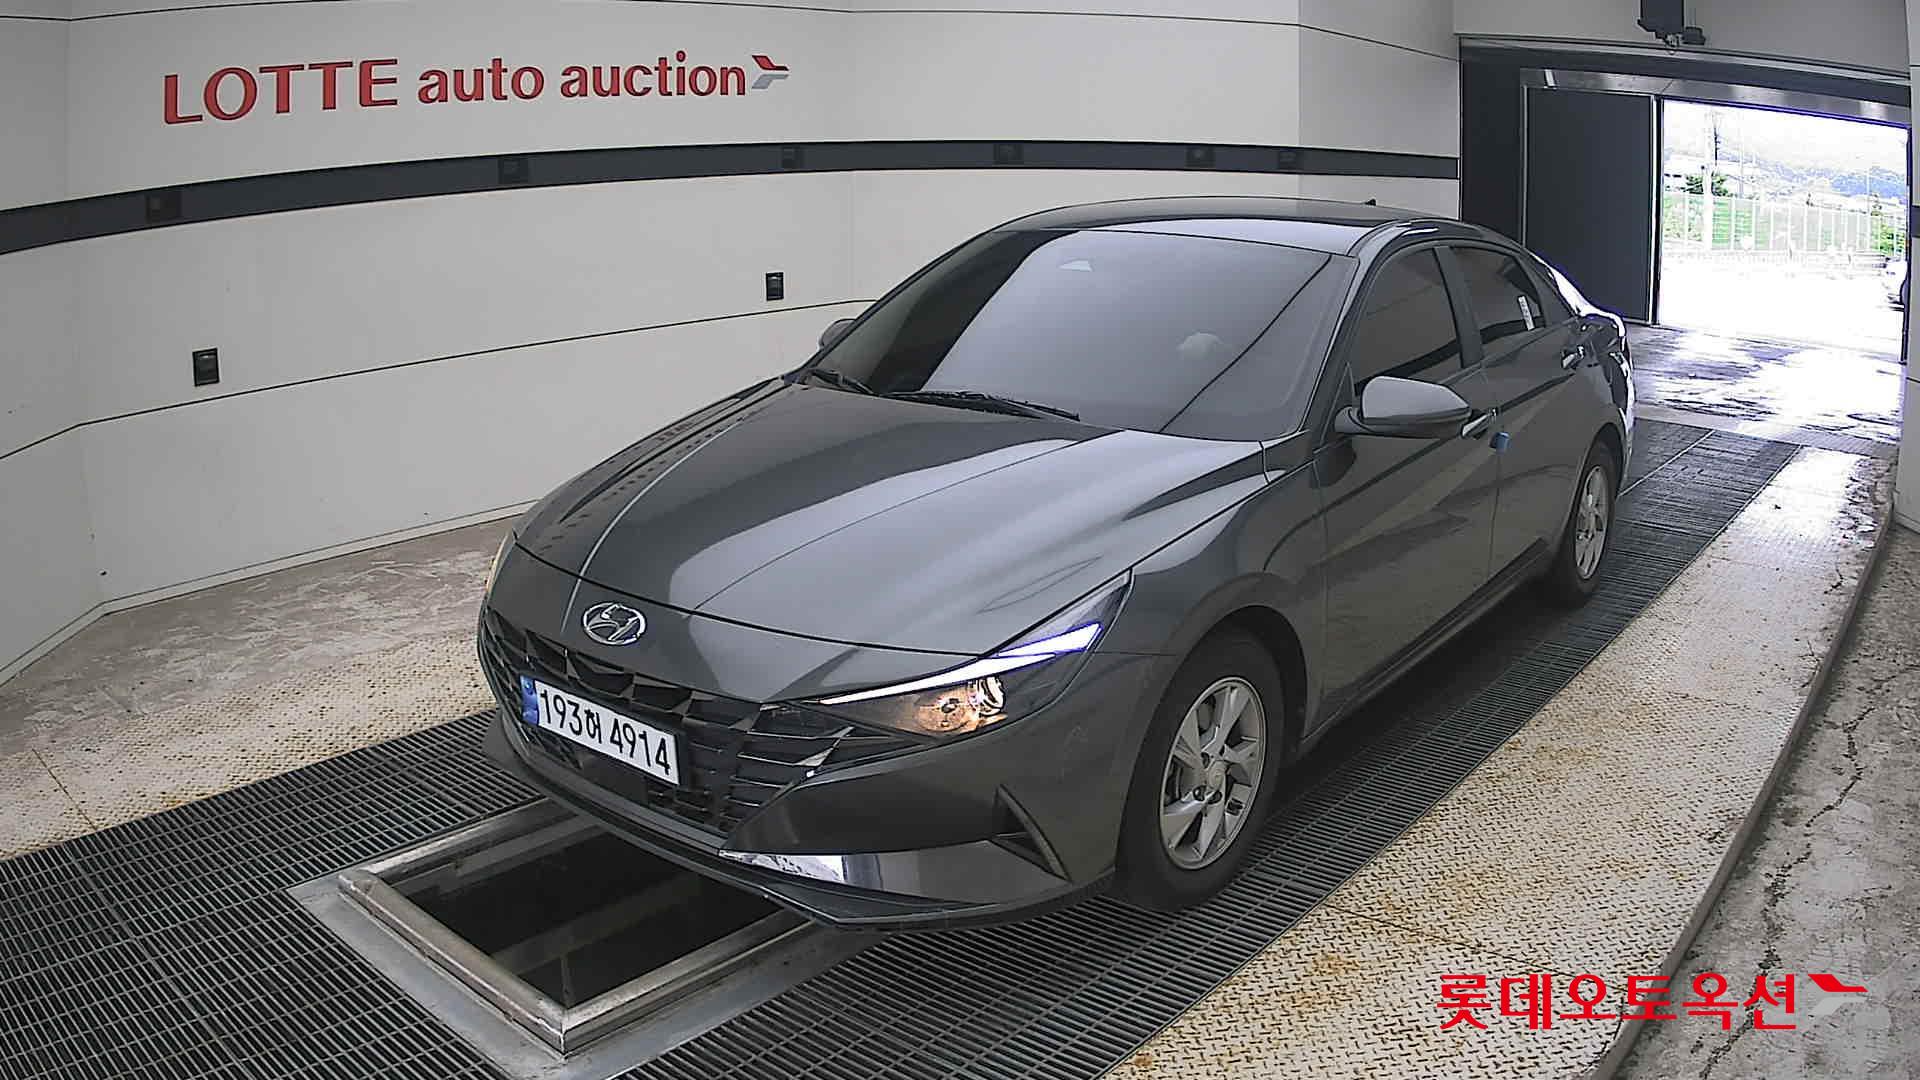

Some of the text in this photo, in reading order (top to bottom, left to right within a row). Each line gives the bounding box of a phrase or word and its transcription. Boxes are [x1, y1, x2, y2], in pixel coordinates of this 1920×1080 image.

[163, 50, 747, 125] LOTTE auto auction
[540, 689, 672, 776] 193허 4914
